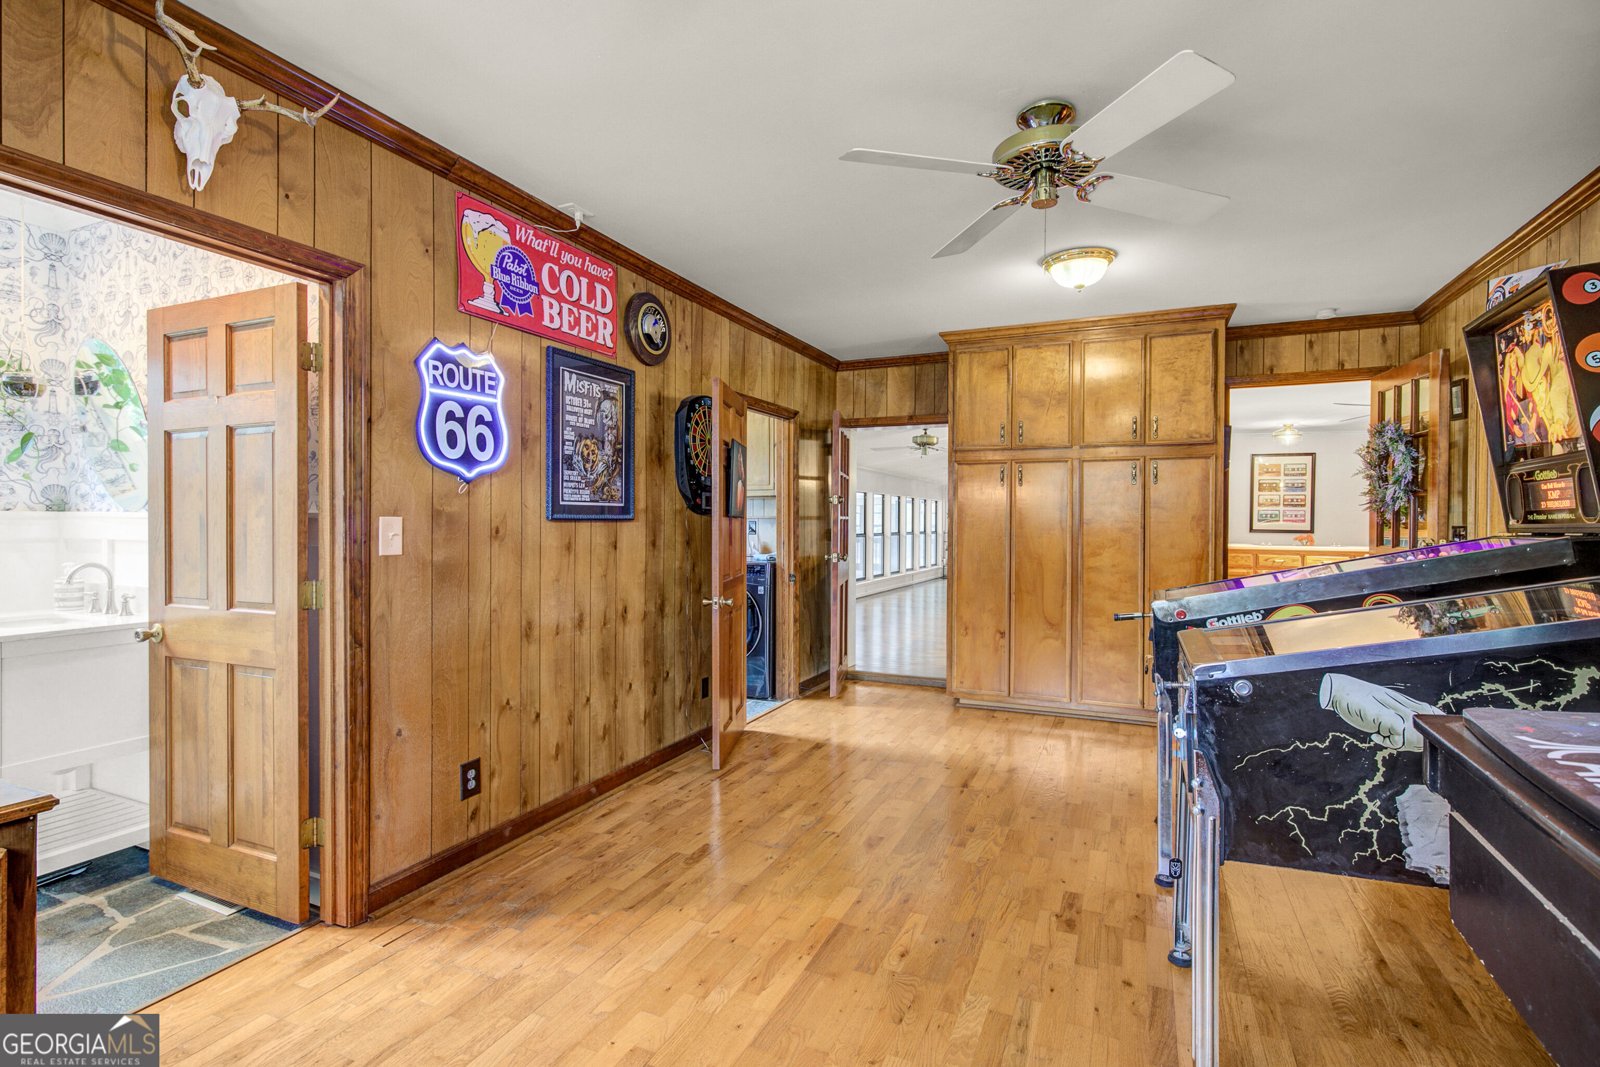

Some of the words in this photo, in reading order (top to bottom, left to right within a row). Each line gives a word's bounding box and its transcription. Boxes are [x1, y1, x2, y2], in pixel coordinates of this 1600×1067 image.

[502, 252, 528, 276] Pabst
[515, 224, 559, 258] What'll
[560, 250, 582, 268] you
[584, 257, 614, 282] have?
[492, 265, 511, 284] Blue
[511, 272, 539, 295] Ribbon
[541, 262, 614, 314] COLD
[1589, 281, 1598, 290] 3
[541, 294, 614, 349] BEER
[428, 359, 497, 395] ROUTE
[564, 371, 601, 398] MISFITS
[436, 400, 495, 462] 66
[1535, 470, 1558, 480] Gottlieb
[1206, 612, 1262, 629] Gottlieb
